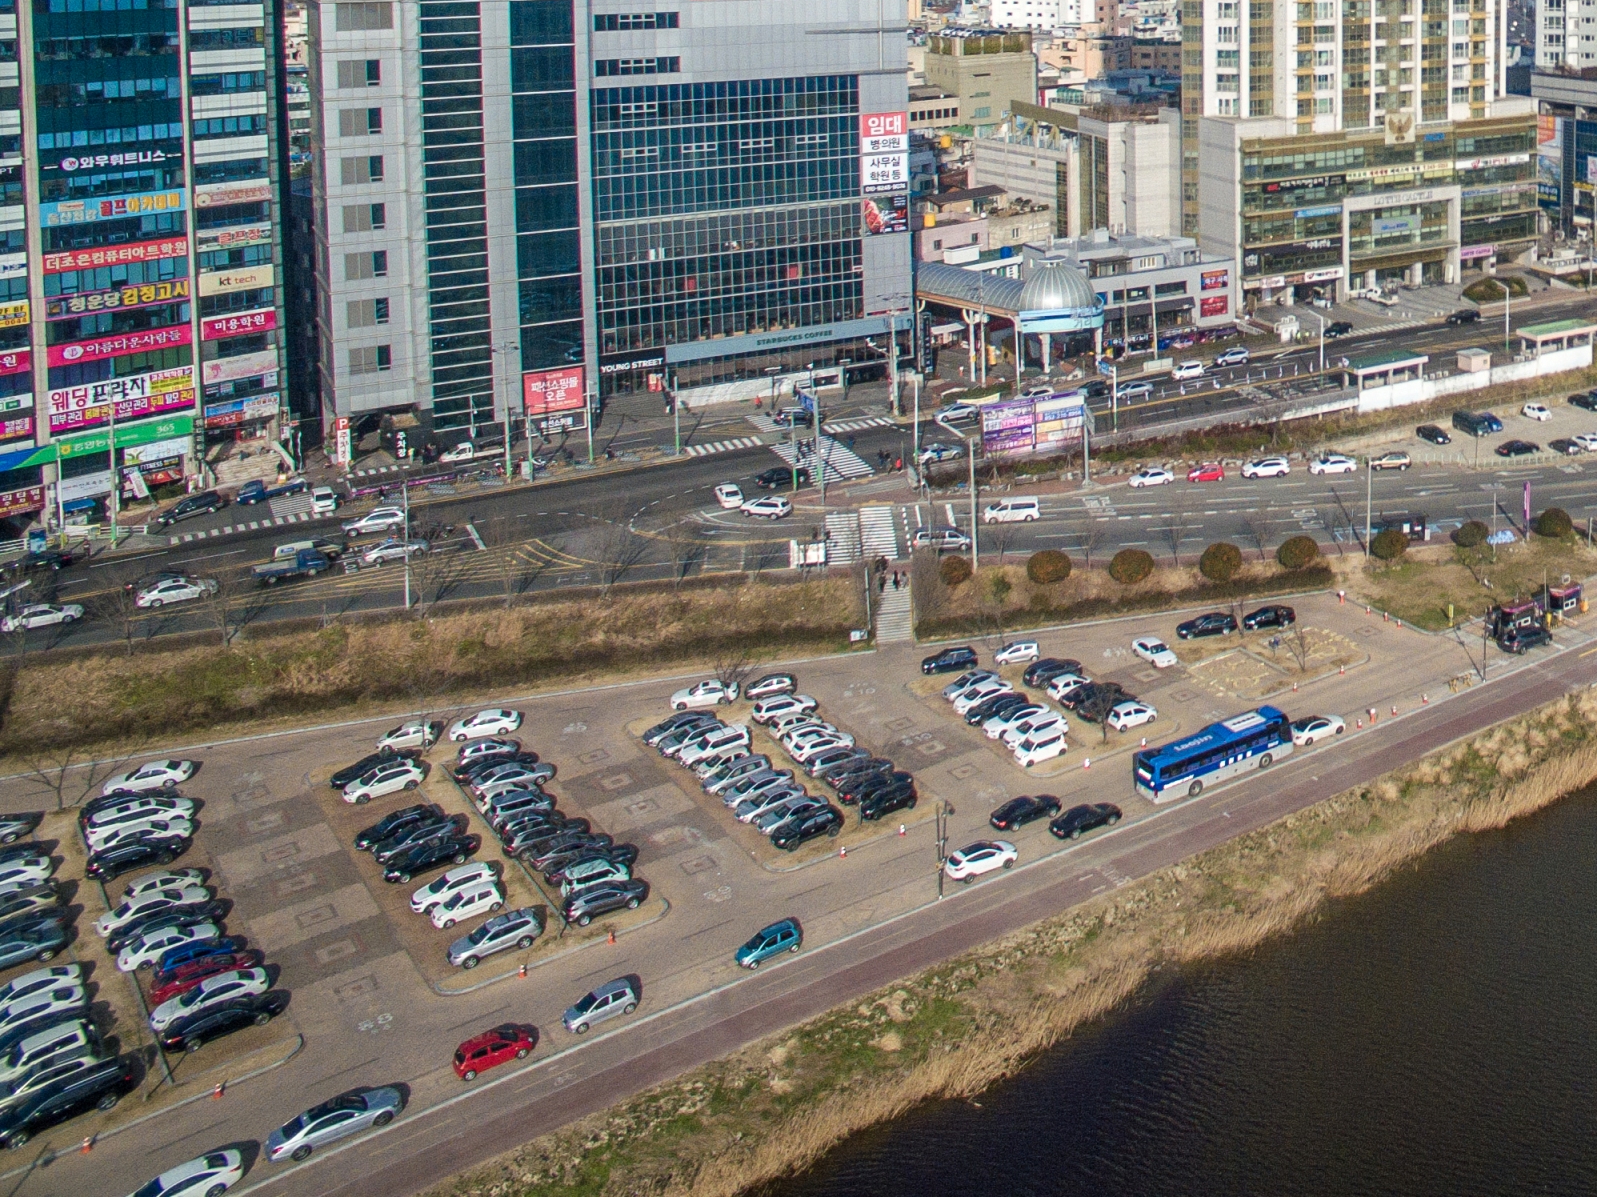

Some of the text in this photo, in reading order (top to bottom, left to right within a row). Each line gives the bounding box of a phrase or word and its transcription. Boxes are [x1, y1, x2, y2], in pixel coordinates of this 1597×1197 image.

[867, 115, 902, 136] 임대
[80, 150, 166, 169] 와우휘트니스
[870, 155, 900, 168] 사무실
[870, 169, 901, 182] 학원 등
[1374, 191, 1433, 206] LOTTE CASTLE
[45, 240, 187, 269] 더조은컴퓨터아트학원
[219, 275, 257, 286] kt tech
[122, 280, 189, 305] 검정고시
[214, 314, 265, 331] 미용학원
[86, 330, 181, 354] 아름다운사람들
[756, 329, 833, 346] STARBUCKS COFFEE
[601, 357, 664, 373] YOUNG STREET
[51, 387, 88, 412] 웨딩
[545, 389, 566, 402] 오픈
[339, 418, 348, 430] P
